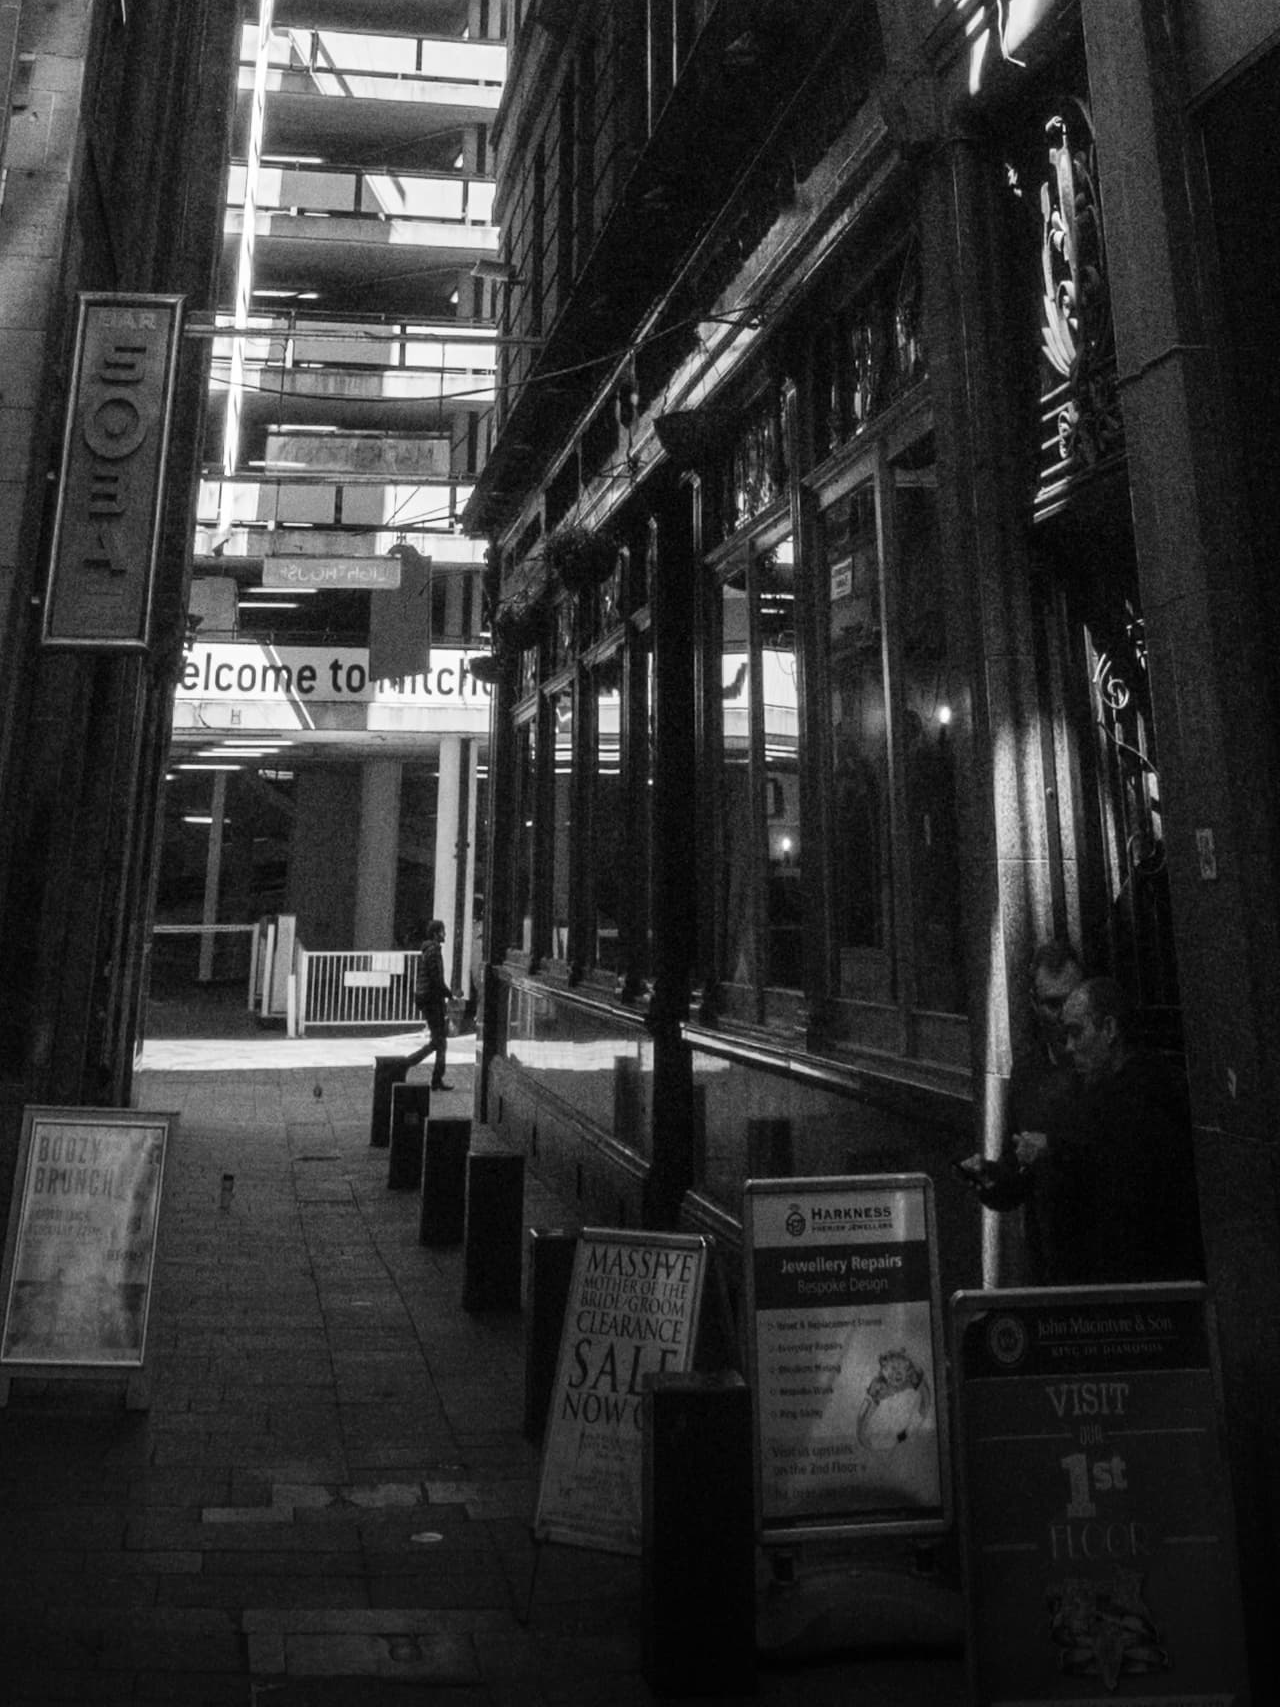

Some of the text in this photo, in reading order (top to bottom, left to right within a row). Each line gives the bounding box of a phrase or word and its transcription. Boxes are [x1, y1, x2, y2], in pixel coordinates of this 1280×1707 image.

[183, 653, 317, 693] elcome
[330, 659, 365, 694] to
[34, 1166, 113, 1196] BRUNCH
[812, 1206, 892, 1220] HARKNESS
[587, 1245, 693, 1283] MASSIVE
[781, 1254, 903, 1275] Jewellery Repairs
[583, 1274, 688, 1299] MOTHER OF THE
[797, 1277, 888, 1294] Bespoke Design
[576, 1311, 683, 1344] CLEARANCE
[1037, 1316, 1067, 1339] John
[1147, 1314, 1173, 1331] Son
[562, 1393, 631, 1425] NOW
[1045, 1383, 1131, 1418] VISIT
[1079, 1424, 1105, 1446] OUR
[1060, 1452, 1128, 1518] 1st
